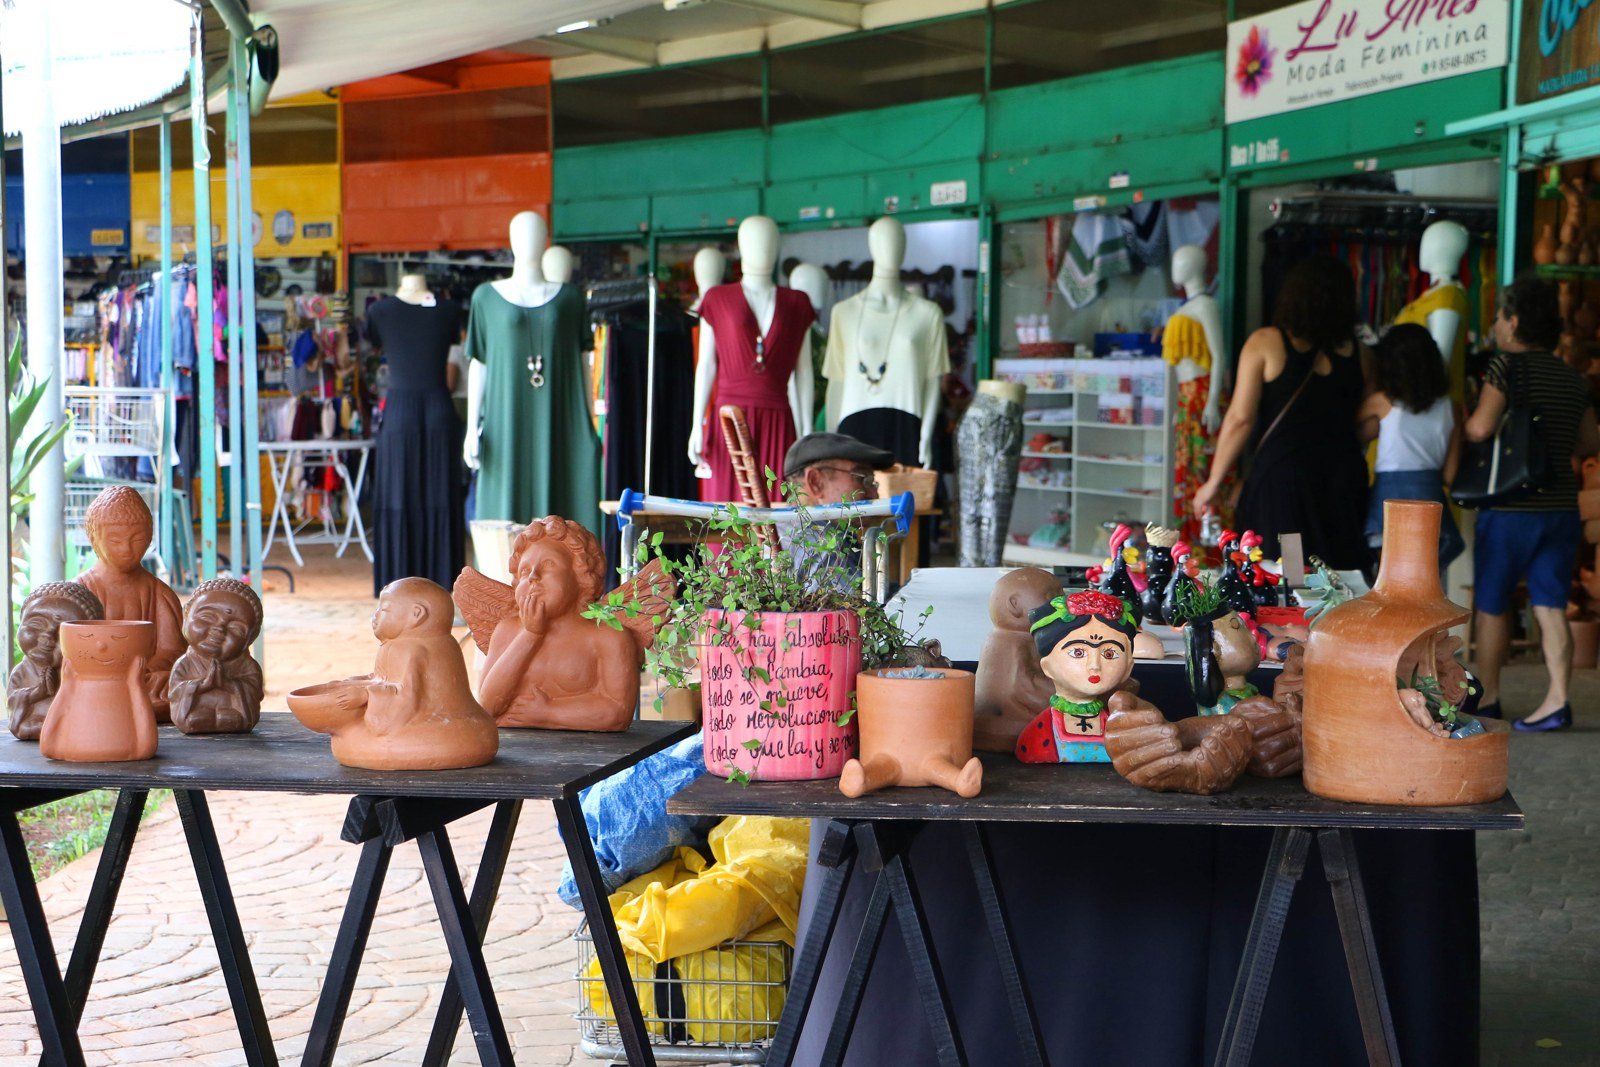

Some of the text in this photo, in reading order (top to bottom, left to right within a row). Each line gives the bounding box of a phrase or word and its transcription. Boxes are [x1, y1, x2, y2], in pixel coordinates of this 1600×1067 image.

[1284, 0, 1358, 60] Lu
[1286, 24, 1488, 86] Moda Feminina
[748, 622, 777, 662] hay
[707, 652, 733, 682] todo
[708, 682, 733, 707] todo
[740, 690, 755, 705] se
[709, 709, 736, 732] todo
[710, 736, 738, 763] todo
[815, 739, 825, 769] y
